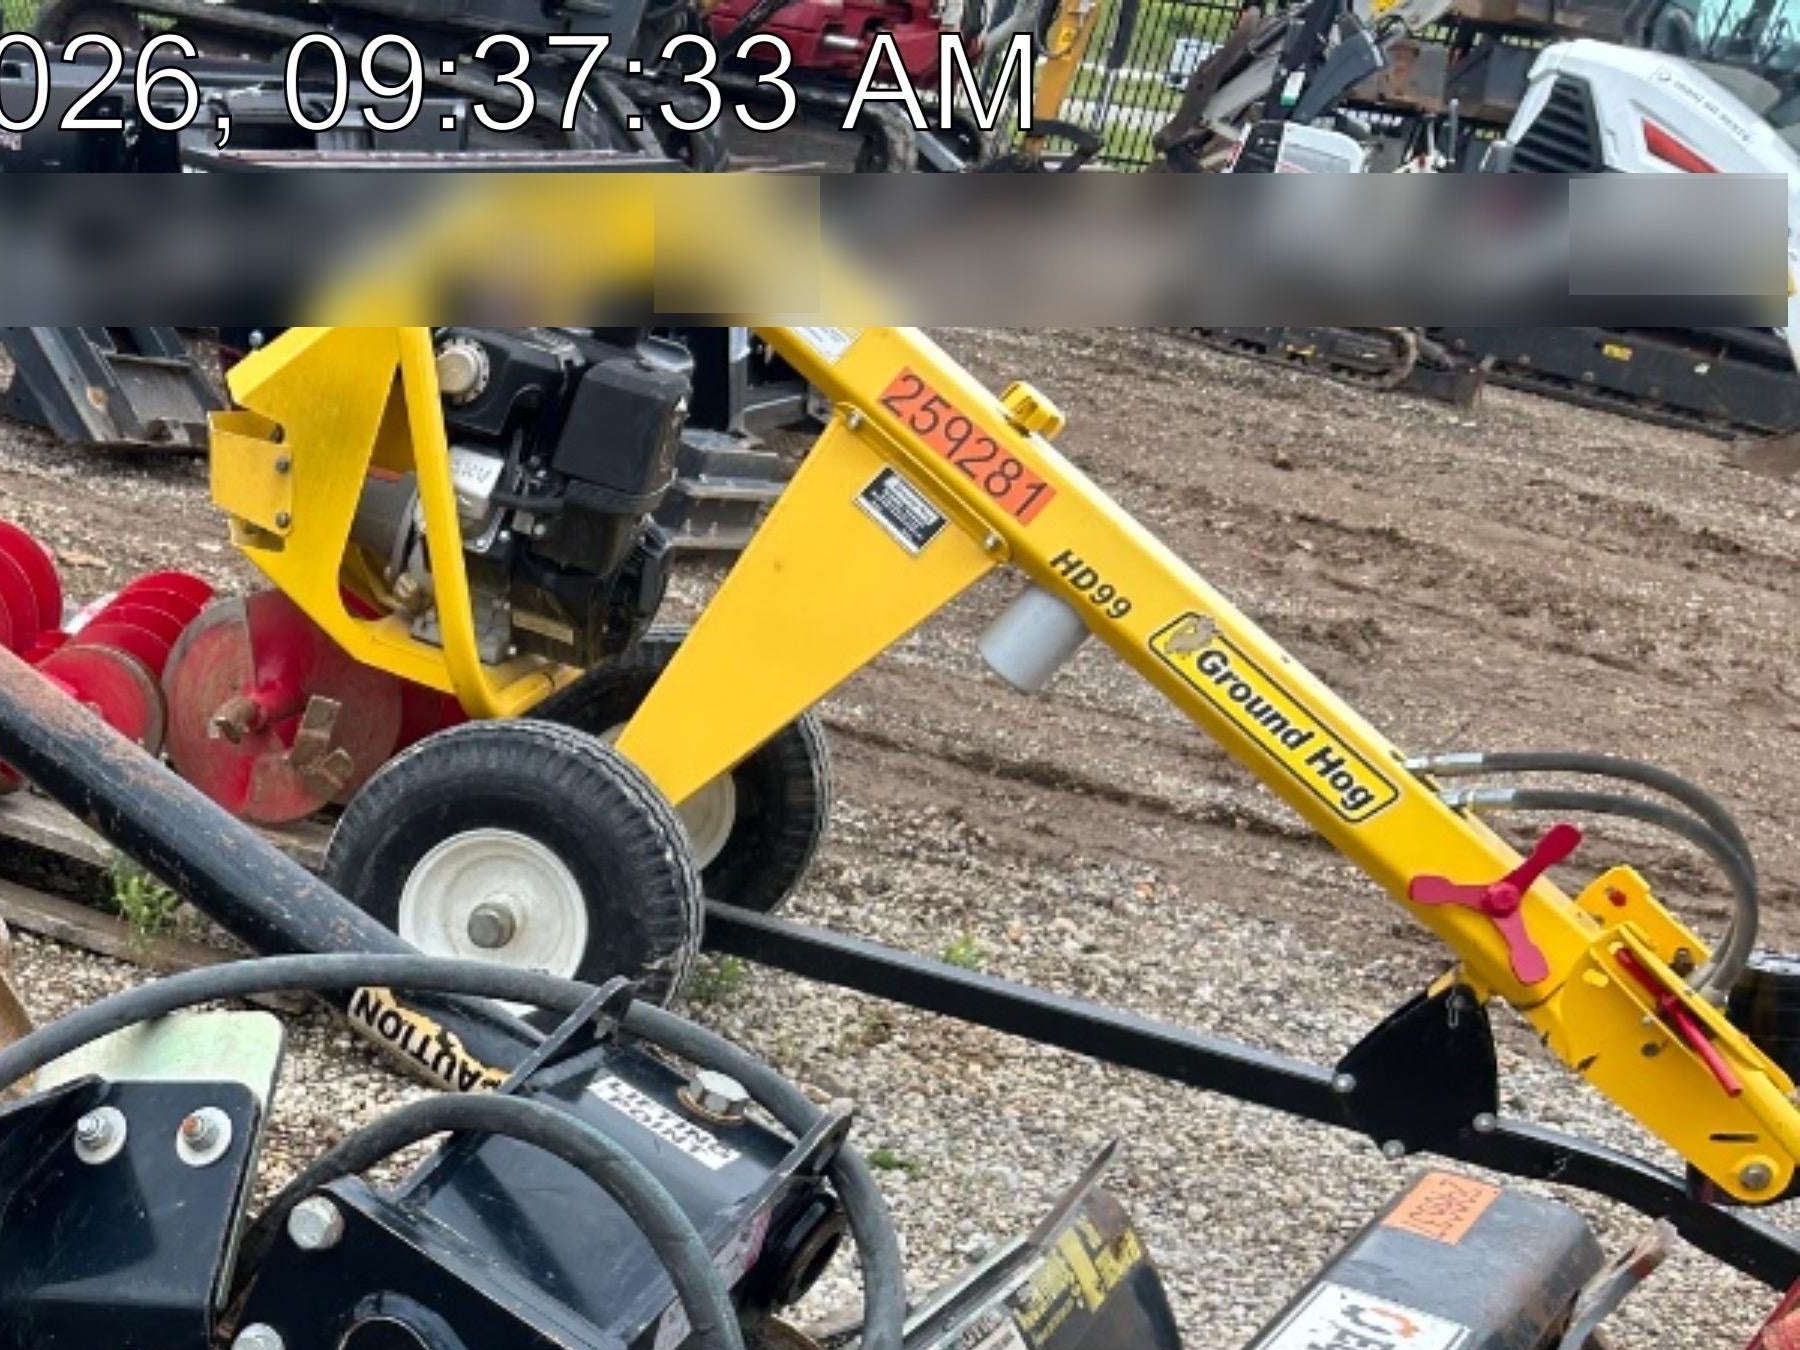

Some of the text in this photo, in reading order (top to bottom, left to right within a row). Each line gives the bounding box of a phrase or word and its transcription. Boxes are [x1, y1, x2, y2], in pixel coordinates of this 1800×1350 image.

[881, 374, 1048, 517] 259281
[1049, 549, 1132, 620] HD99
[1196, 648, 1374, 814] Ground Hog
